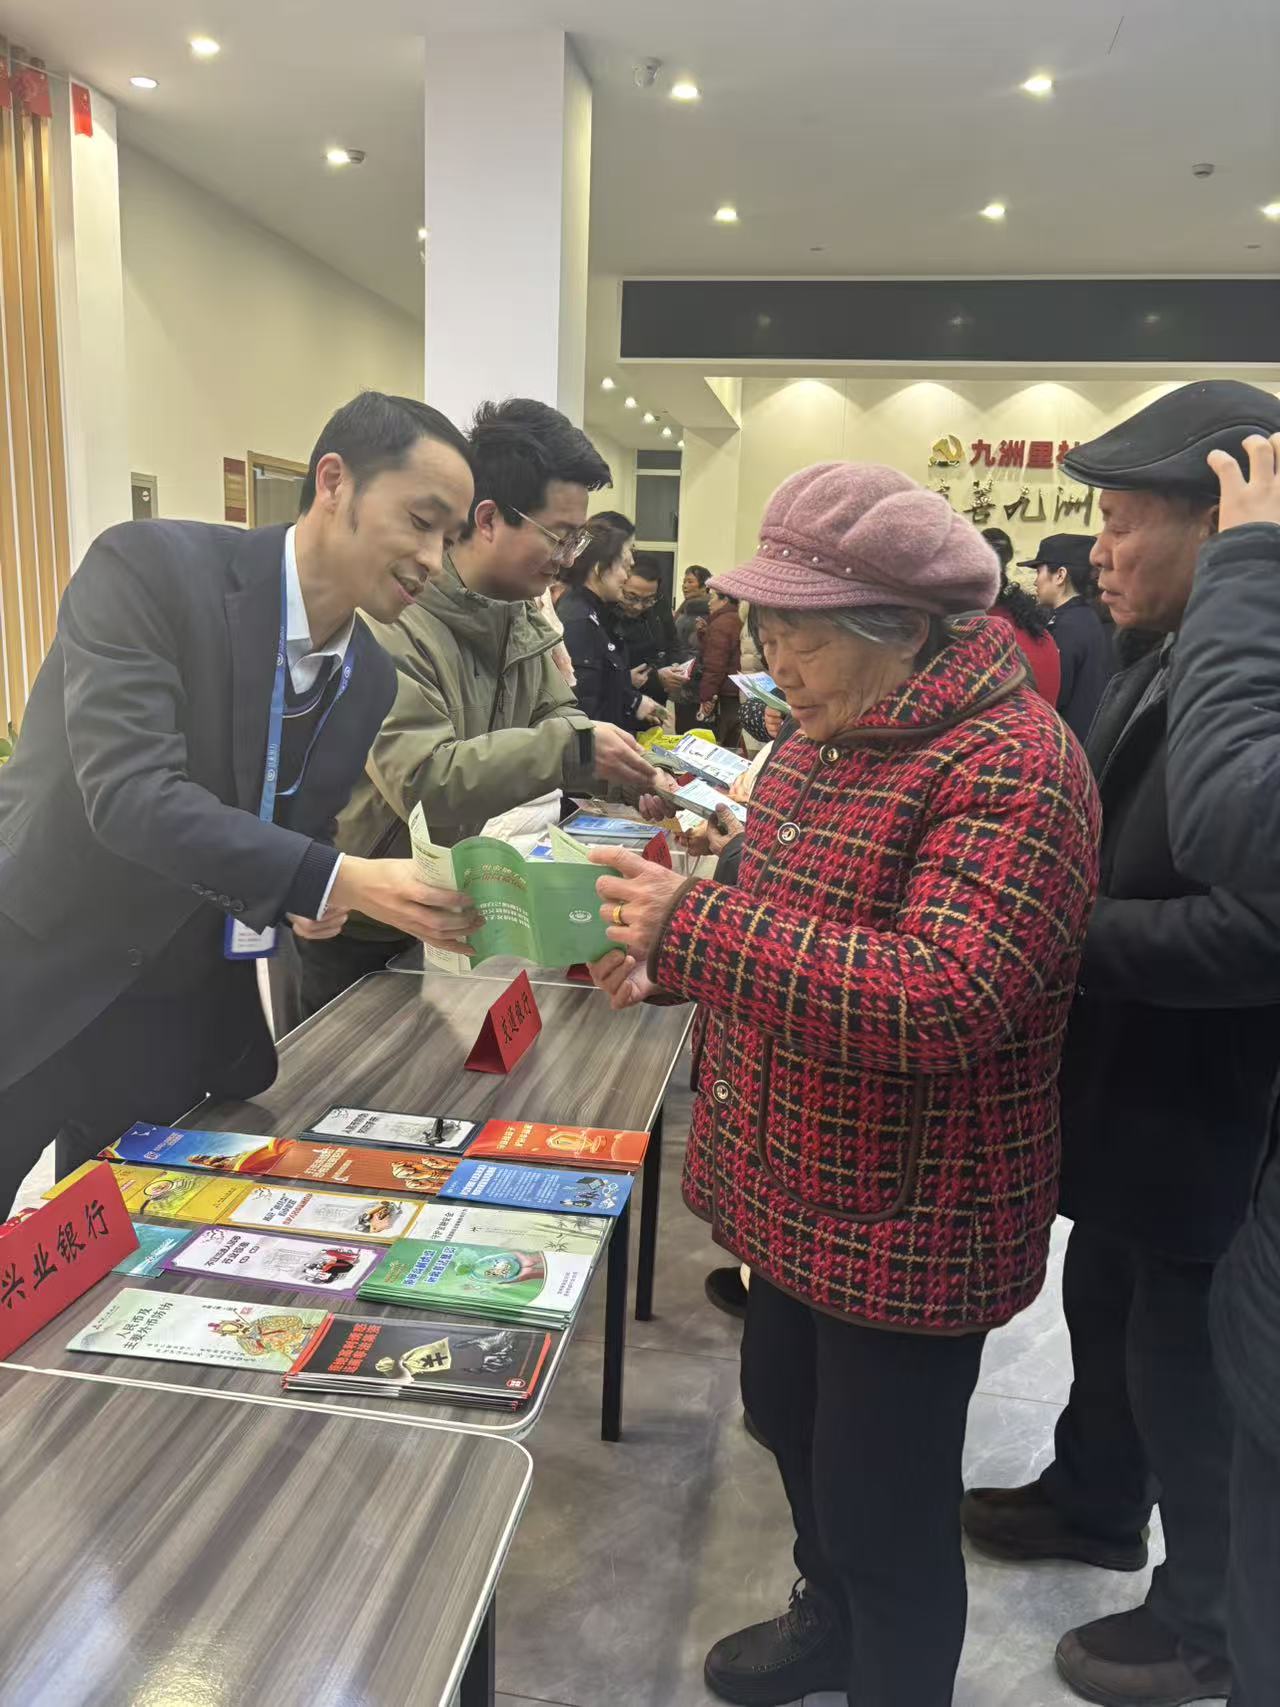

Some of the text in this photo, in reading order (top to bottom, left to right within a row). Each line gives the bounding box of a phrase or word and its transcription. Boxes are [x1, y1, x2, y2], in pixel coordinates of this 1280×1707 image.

[1, 1199, 110, 1310] 兴业银行
[116, 1307, 153, 1339] 人民币及
[123, 1302, 174, 1350] 主要外币防伪
